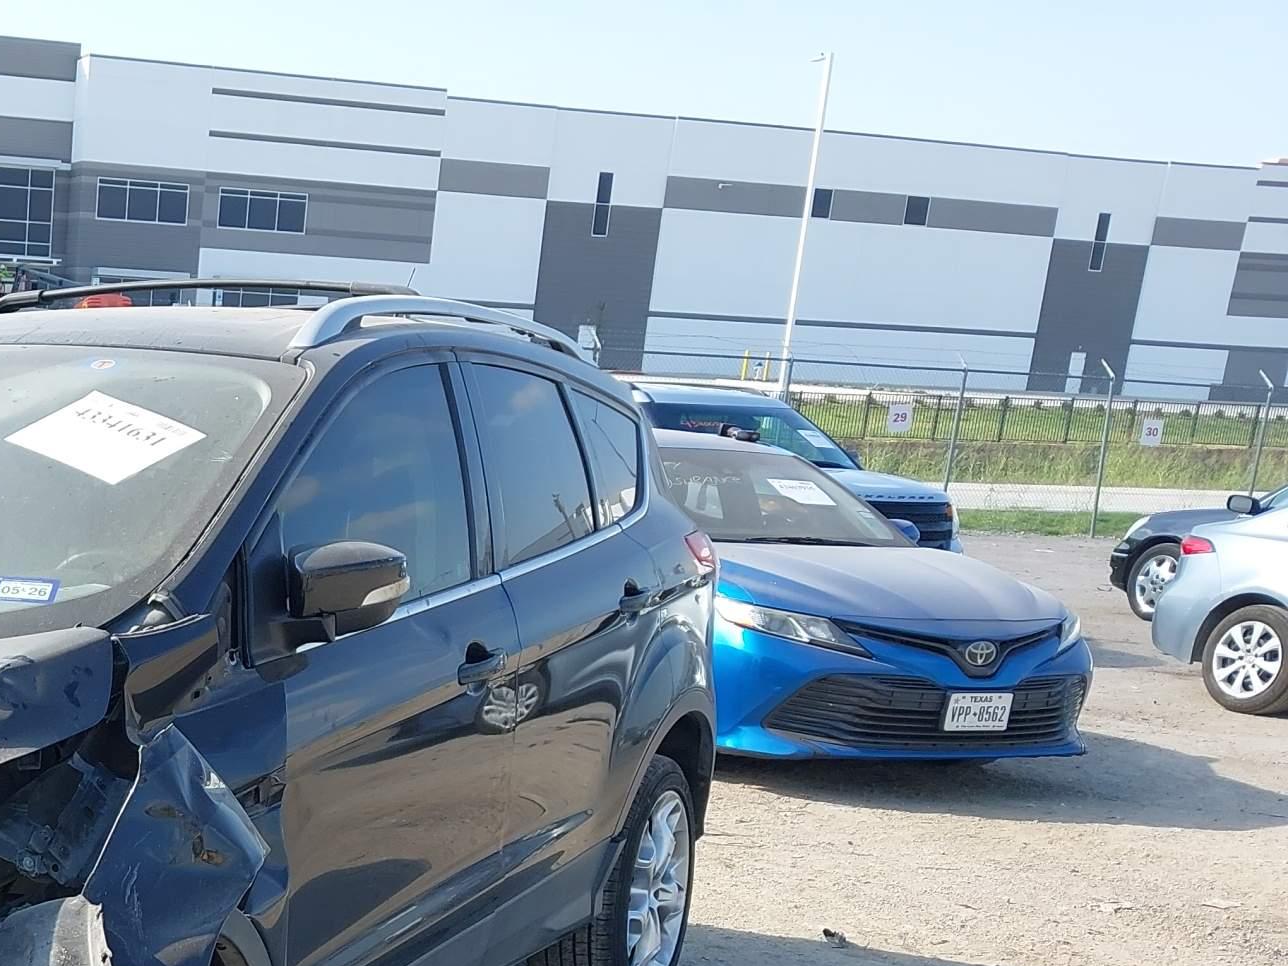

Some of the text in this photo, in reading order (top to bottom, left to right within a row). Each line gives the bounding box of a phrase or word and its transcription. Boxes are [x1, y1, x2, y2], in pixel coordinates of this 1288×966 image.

[892, 412, 908, 423] 29
[75, 408, 169, 447] 43341631
[1145, 427, 1159, 437] 30
[970, 695, 993, 703] TEXAS
